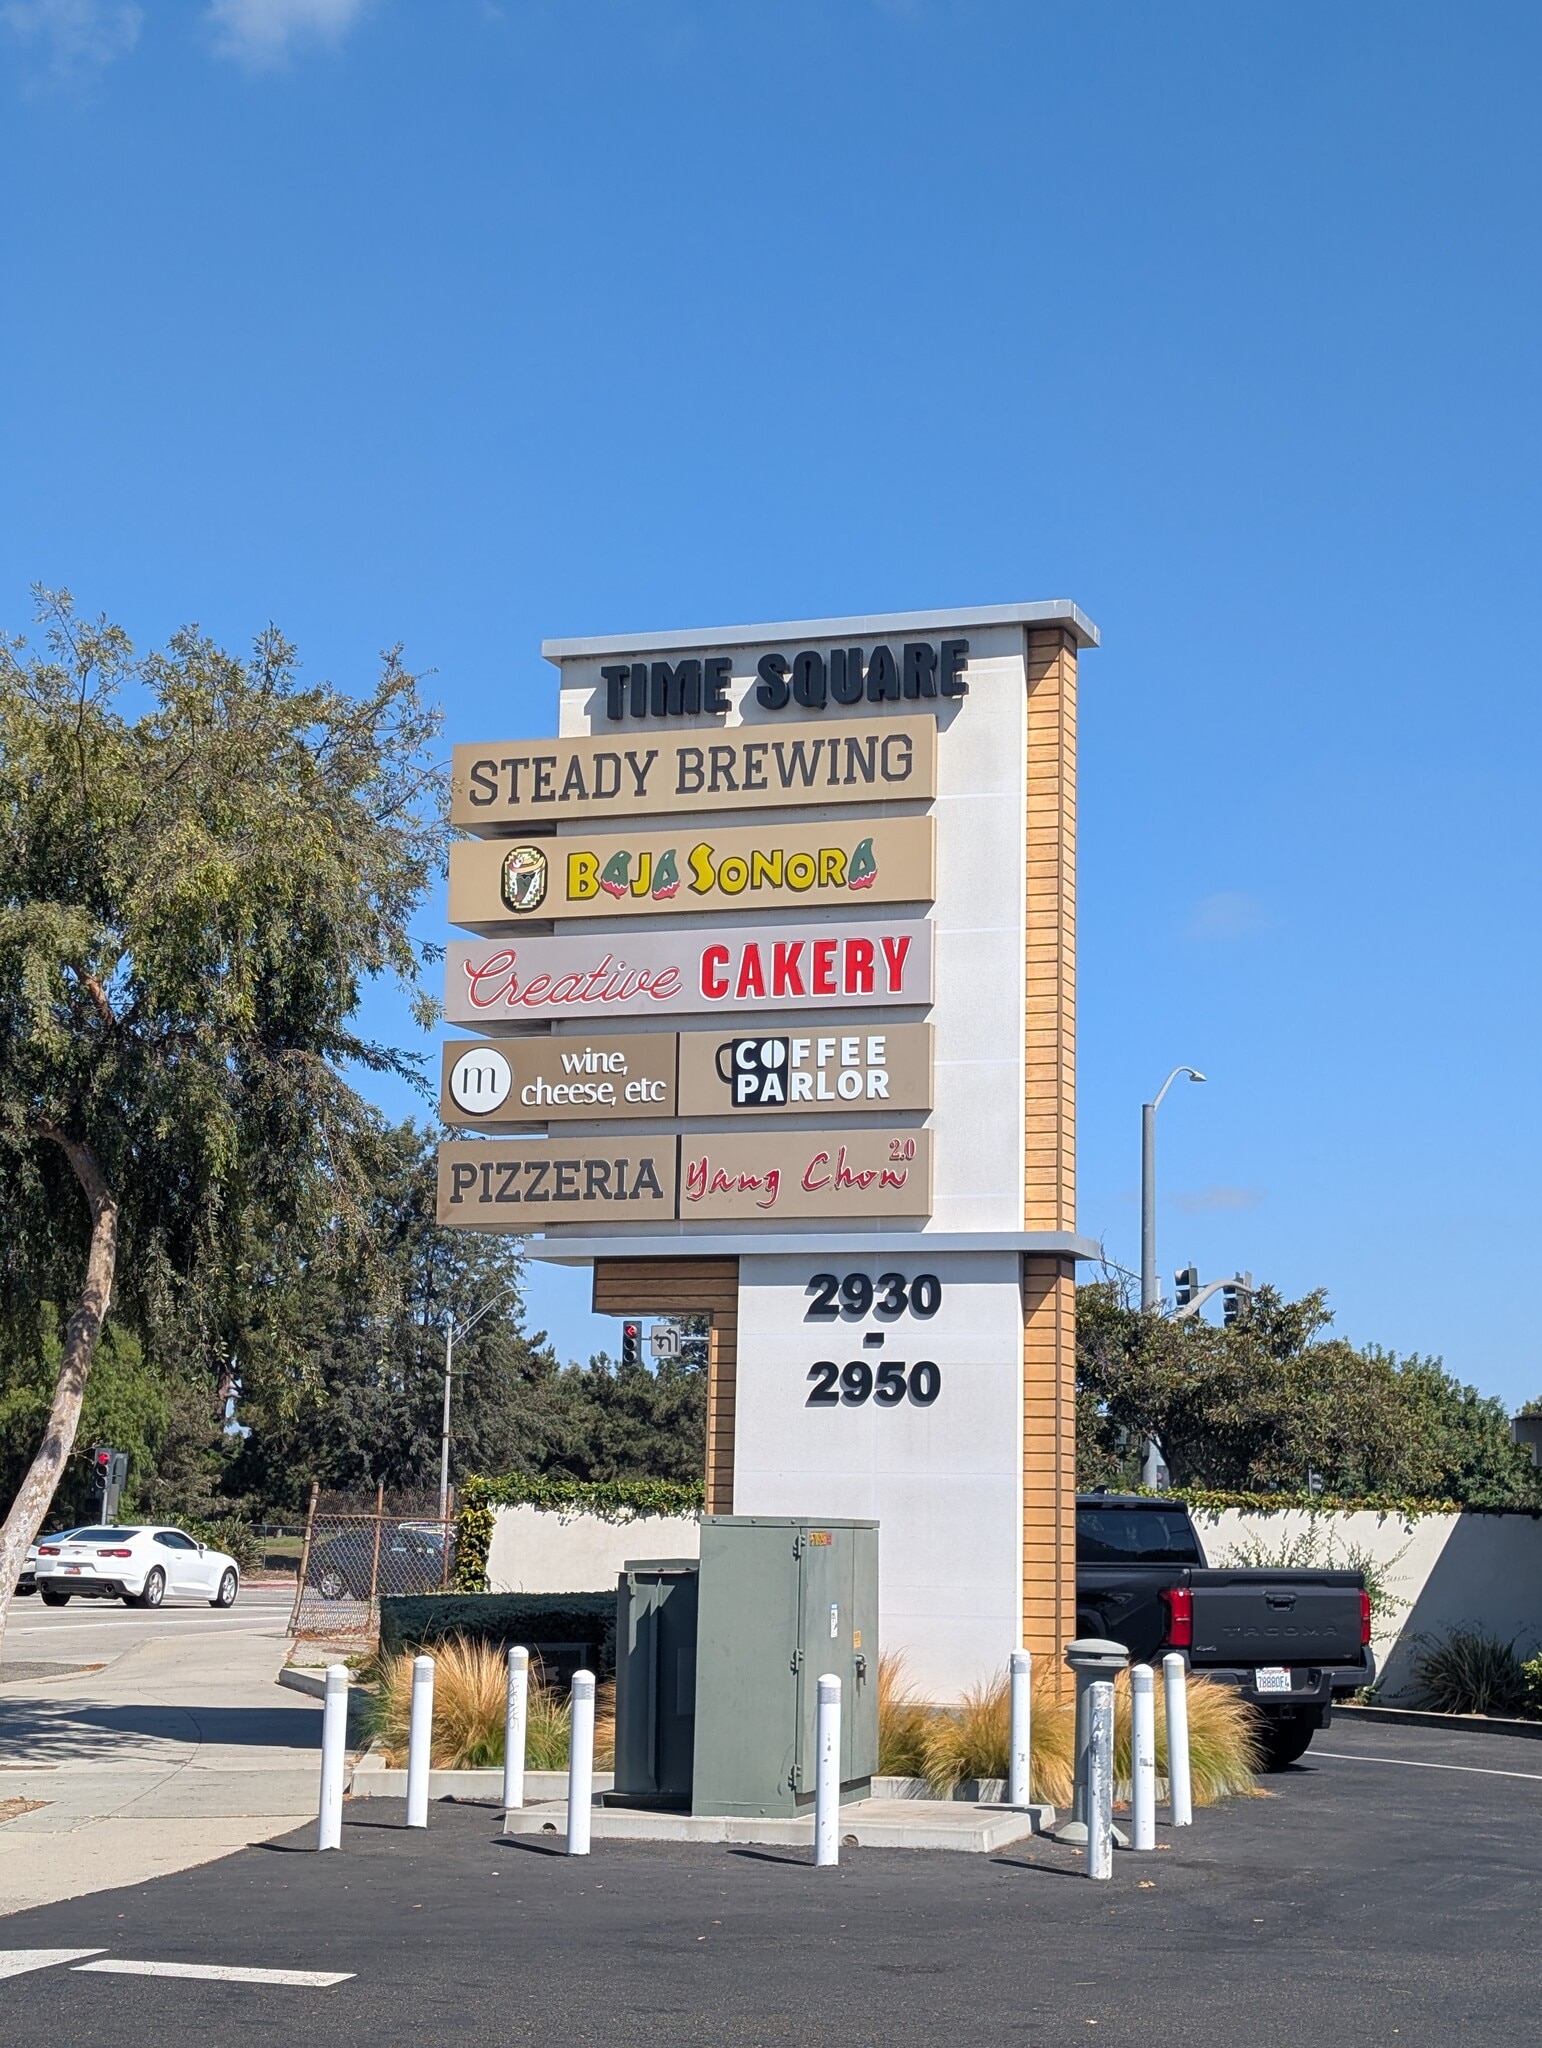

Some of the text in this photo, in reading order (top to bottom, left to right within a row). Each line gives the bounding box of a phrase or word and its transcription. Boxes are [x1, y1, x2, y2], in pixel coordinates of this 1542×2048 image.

[601, 638, 969, 719] TIME SQUARE
[469, 733, 914, 806] STEADY BREWING
[566, 848, 681, 901] BAJA
[462, 935, 914, 1009] Creative CAKERY
[560, 1047, 629, 1077] wine,
[735, 1035, 887, 1070] COFFEE
[462, 1066, 499, 1095] m
[521, 1076, 667, 1107] cheese, etc
[736, 1069, 890, 1103] PARLOR
[449, 1157, 664, 1204] PIZZERIA
[686, 1137, 917, 1208] Yang Chow 2.0
[806, 1272, 942, 1315] 2930
[806, 1360, 941, 1402] 2950
[1222, 1626, 1338, 1637] TACOMA
